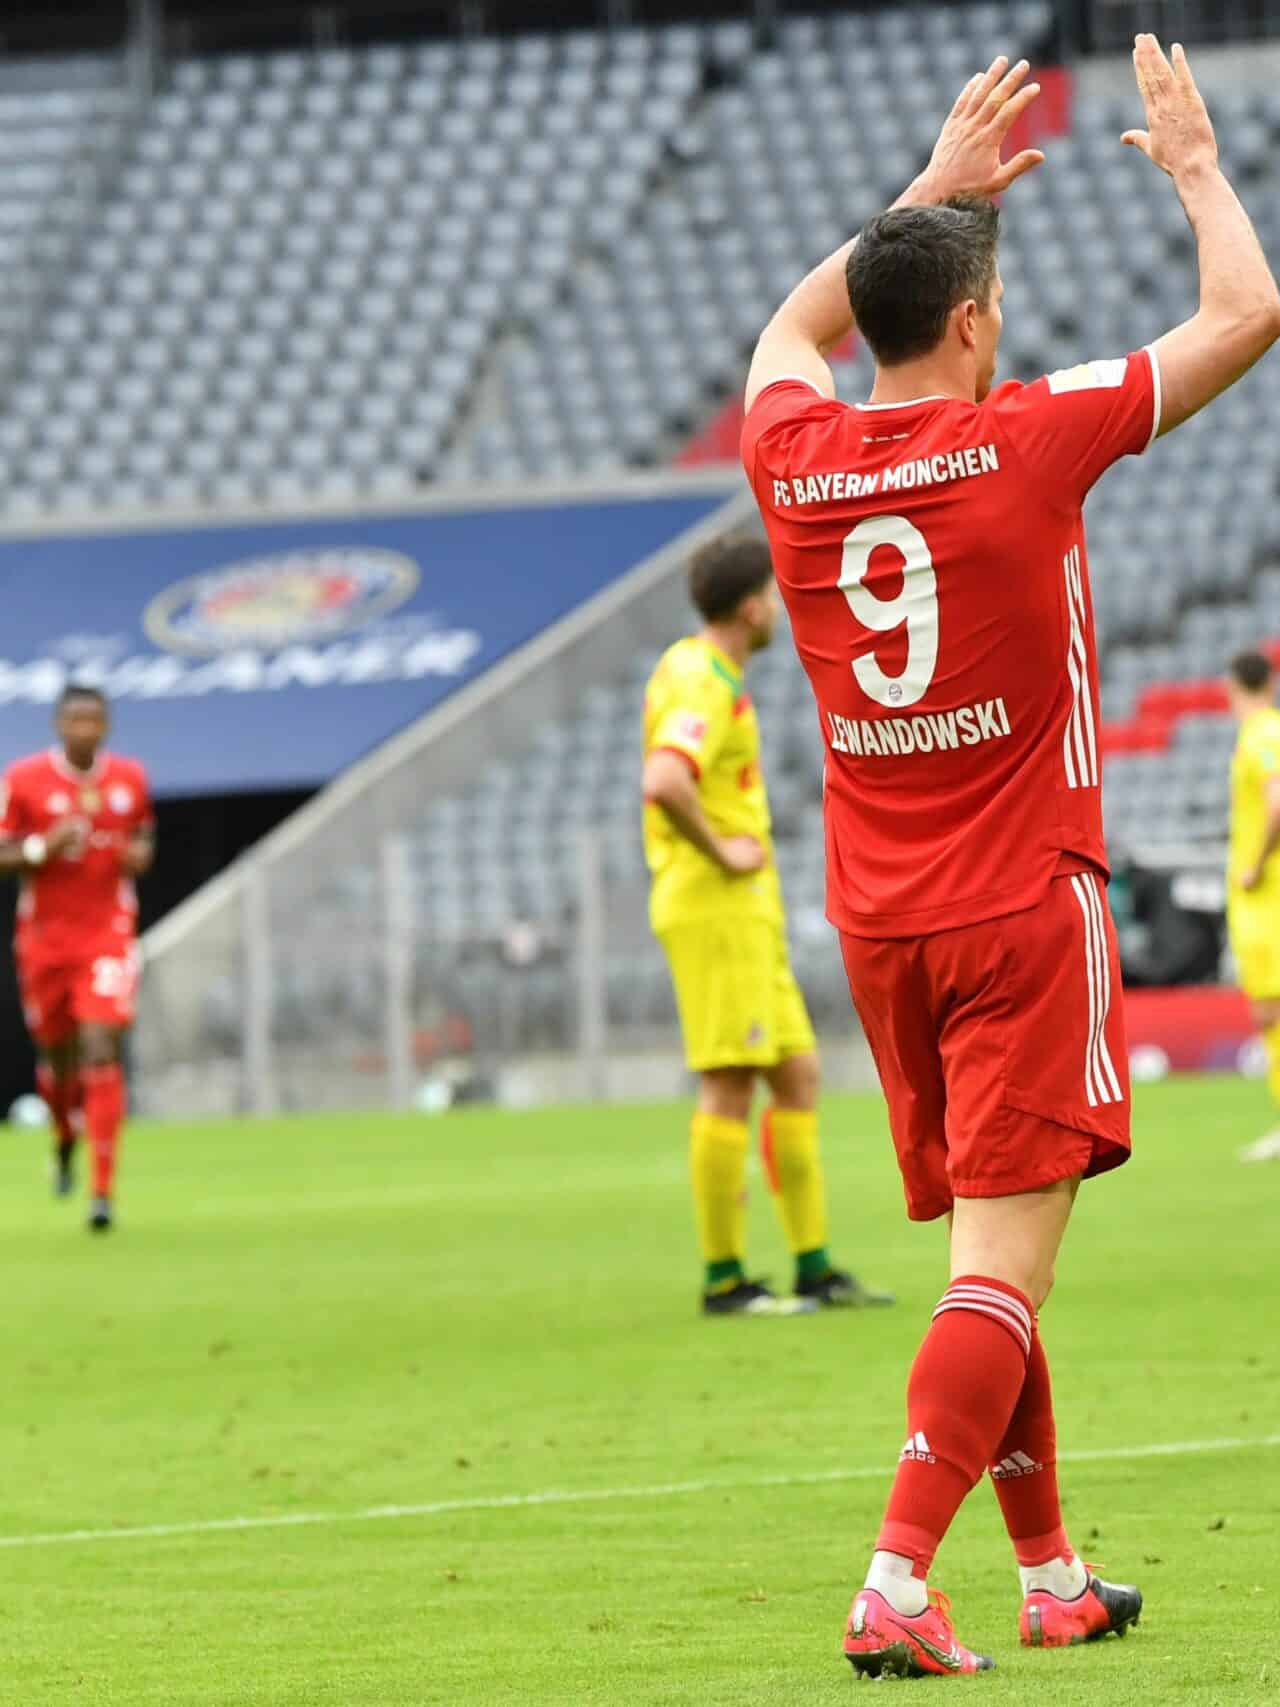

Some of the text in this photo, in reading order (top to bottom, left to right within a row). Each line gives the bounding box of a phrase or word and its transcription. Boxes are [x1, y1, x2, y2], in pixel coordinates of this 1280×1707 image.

[773, 479, 791, 506] FC
[792, 473, 879, 505] BAYERN
[837, 515, 939, 708] 9
